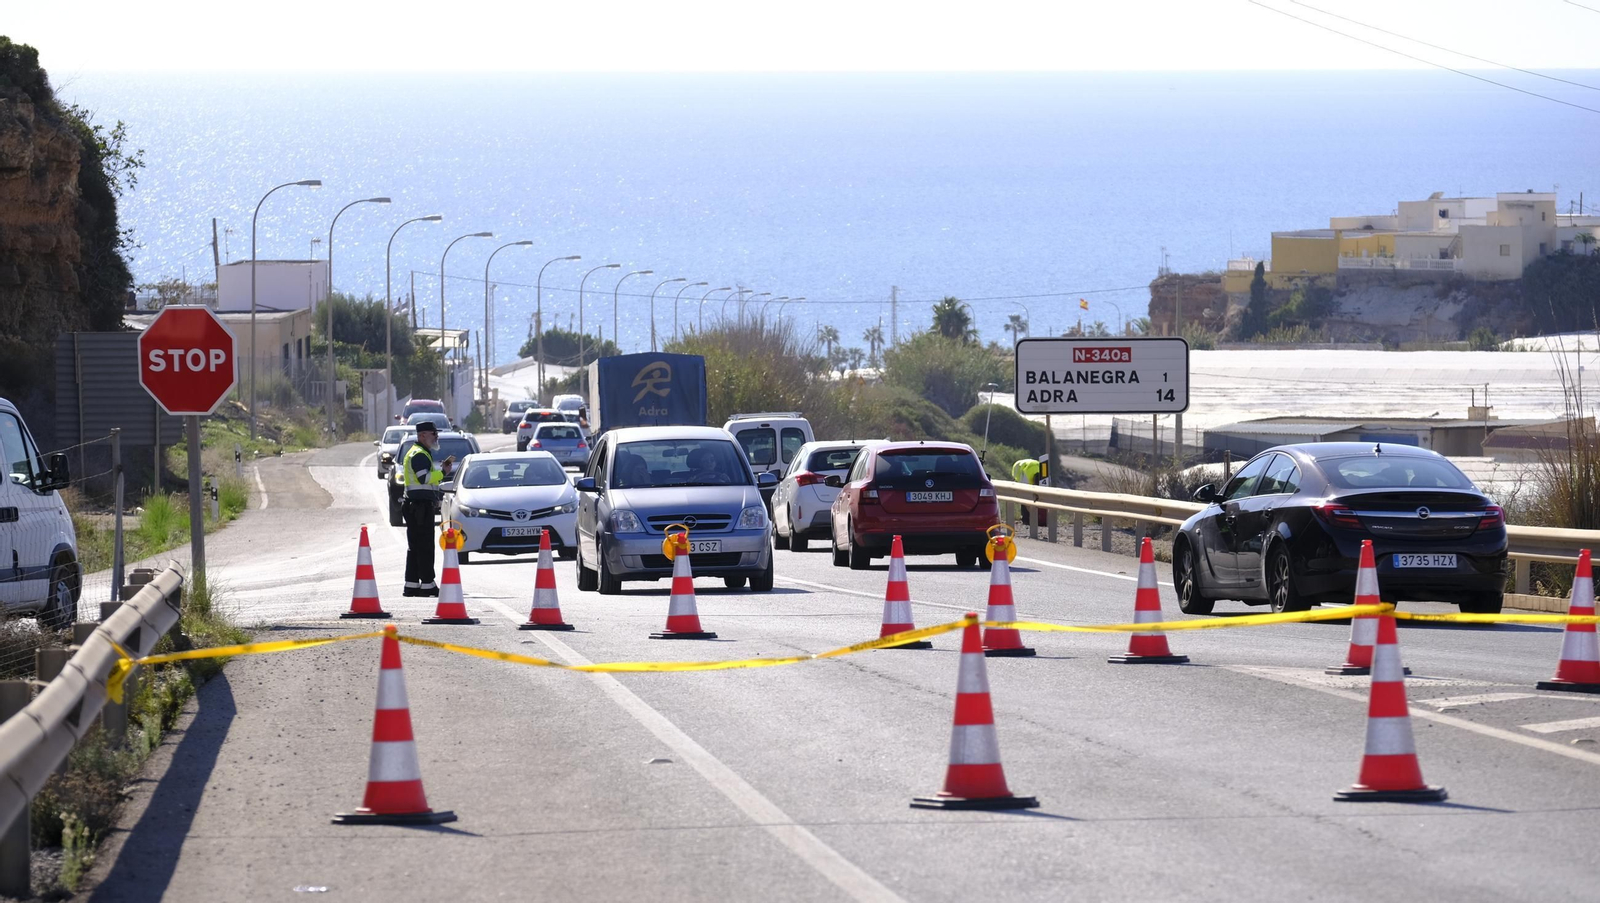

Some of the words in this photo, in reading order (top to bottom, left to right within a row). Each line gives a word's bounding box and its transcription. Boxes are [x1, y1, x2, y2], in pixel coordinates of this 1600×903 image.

[148, 348, 226, 372] STOP
[1074, 349, 1130, 361] N-340a
[1026, 370, 1140, 384] BALANEGRA
[1163, 372, 1168, 383] 1
[1026, 389, 1078, 403] ADRA
[1156, 389, 1175, 402] 14
[638, 405, 668, 416] Adra
[912, 492, 933, 500] 3049
[935, 492, 951, 500] KHJ
[506, 528, 525, 536] 5732
[699, 542, 718, 552] CSZ
[1401, 555, 1430, 566] 3735
[1433, 555, 1454, 566] HZX
